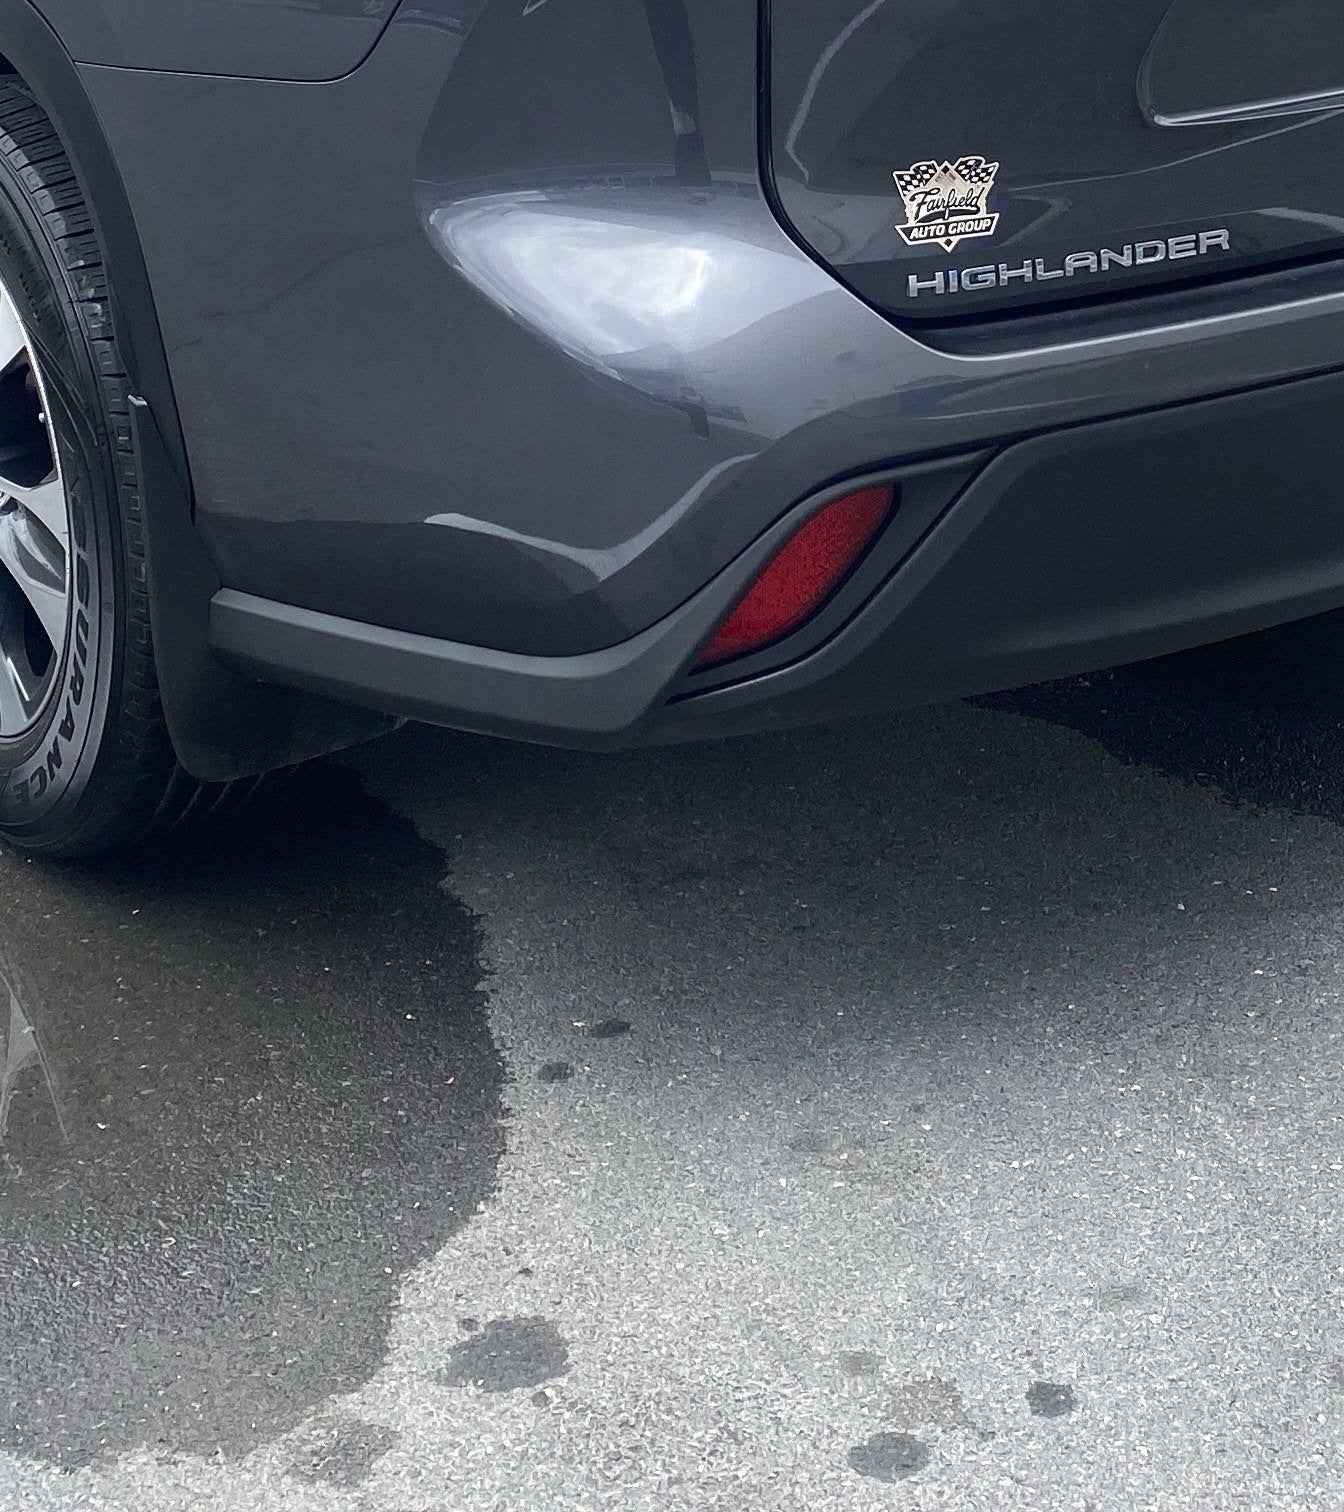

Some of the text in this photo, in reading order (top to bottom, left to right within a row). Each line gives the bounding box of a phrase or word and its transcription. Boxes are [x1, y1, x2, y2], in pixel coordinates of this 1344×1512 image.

[908, 187, 986, 222] Fairfield
[910, 218, 992, 240] AUTO GROUP
[906, 228, 1231, 298] HIGHLANDER
